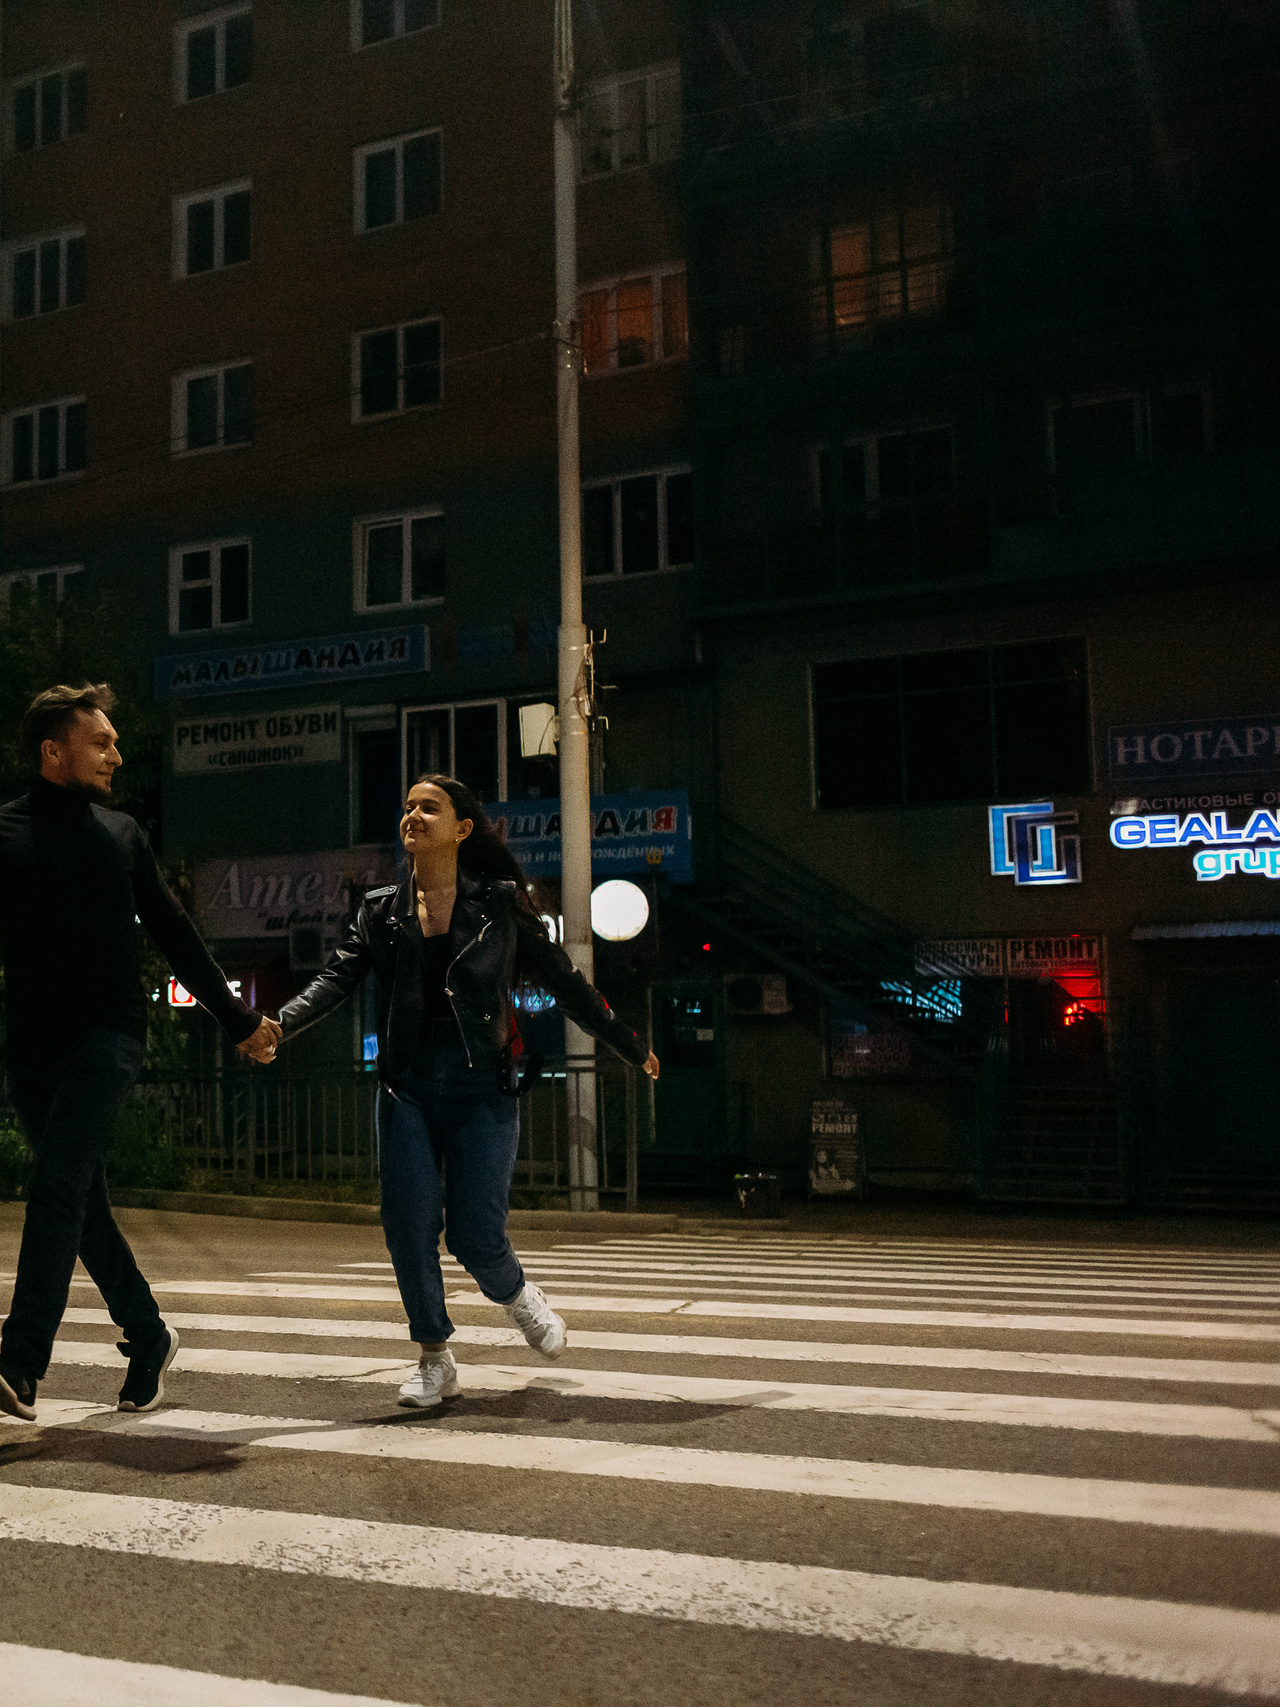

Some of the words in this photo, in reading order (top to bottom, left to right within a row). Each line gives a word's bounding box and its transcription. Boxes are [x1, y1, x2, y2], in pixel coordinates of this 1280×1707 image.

[170, 635, 410, 687] МАЛЫШАНДИЯ
[177, 719, 260, 747] РЕМОНТ
[265, 711, 338, 738] ОБУВИ
[1113, 726, 1280, 766] НОТАР
[1110, 793, 1255, 814] АСТИКОВЫЕ
[1263, 791, 1280, 806] О
[1109, 809, 1280, 850] GEALA
[1010, 938, 1097, 959] РЕМОНТ
